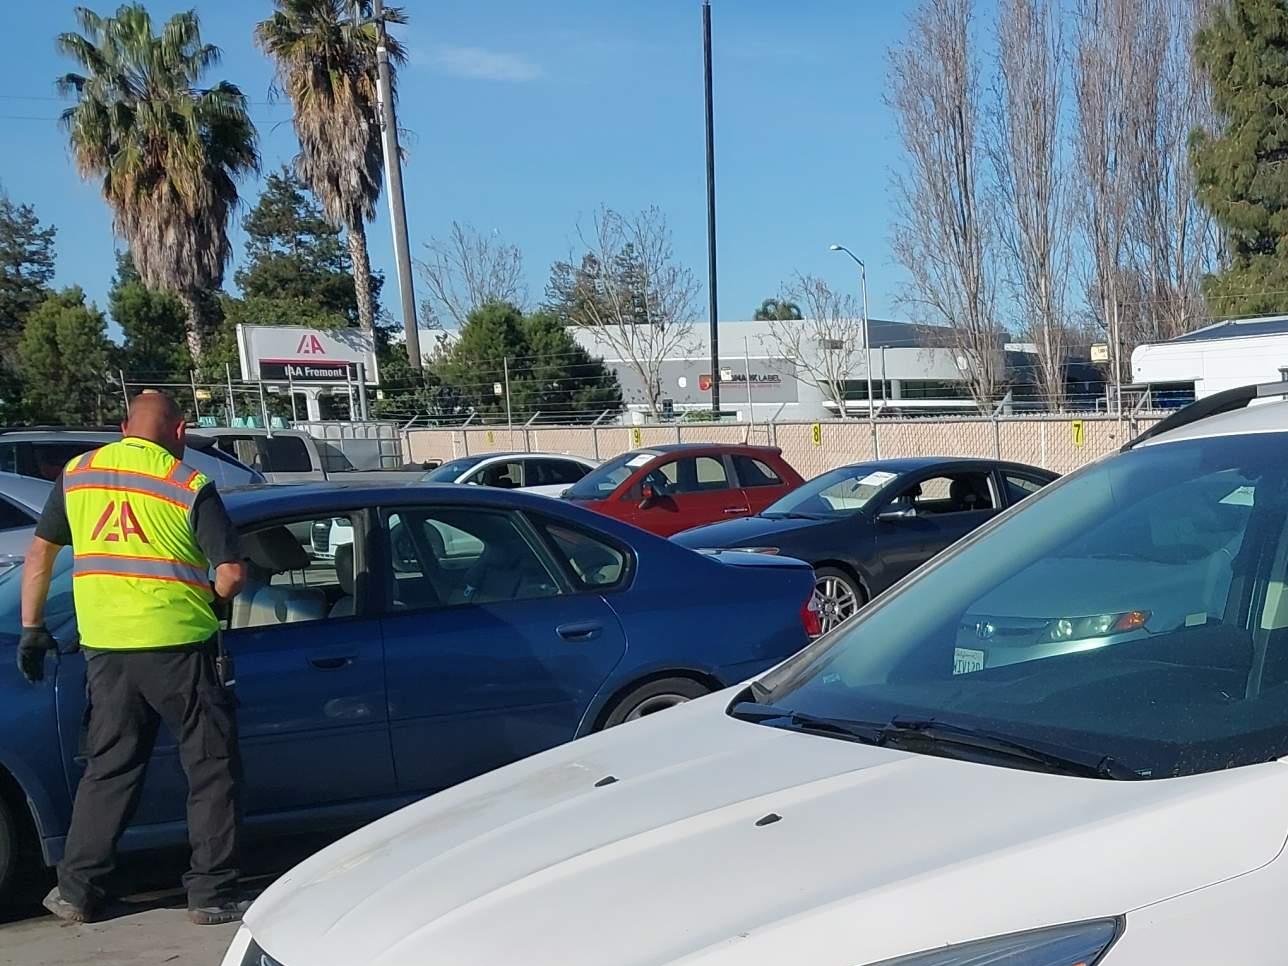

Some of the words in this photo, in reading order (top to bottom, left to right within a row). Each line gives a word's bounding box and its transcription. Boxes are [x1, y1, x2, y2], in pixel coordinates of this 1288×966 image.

[284, 366, 303, 377] IAA
[304, 366, 343, 377] Fremont
[813, 425, 819, 442] 8
[1073, 423, 1081, 443] 7
